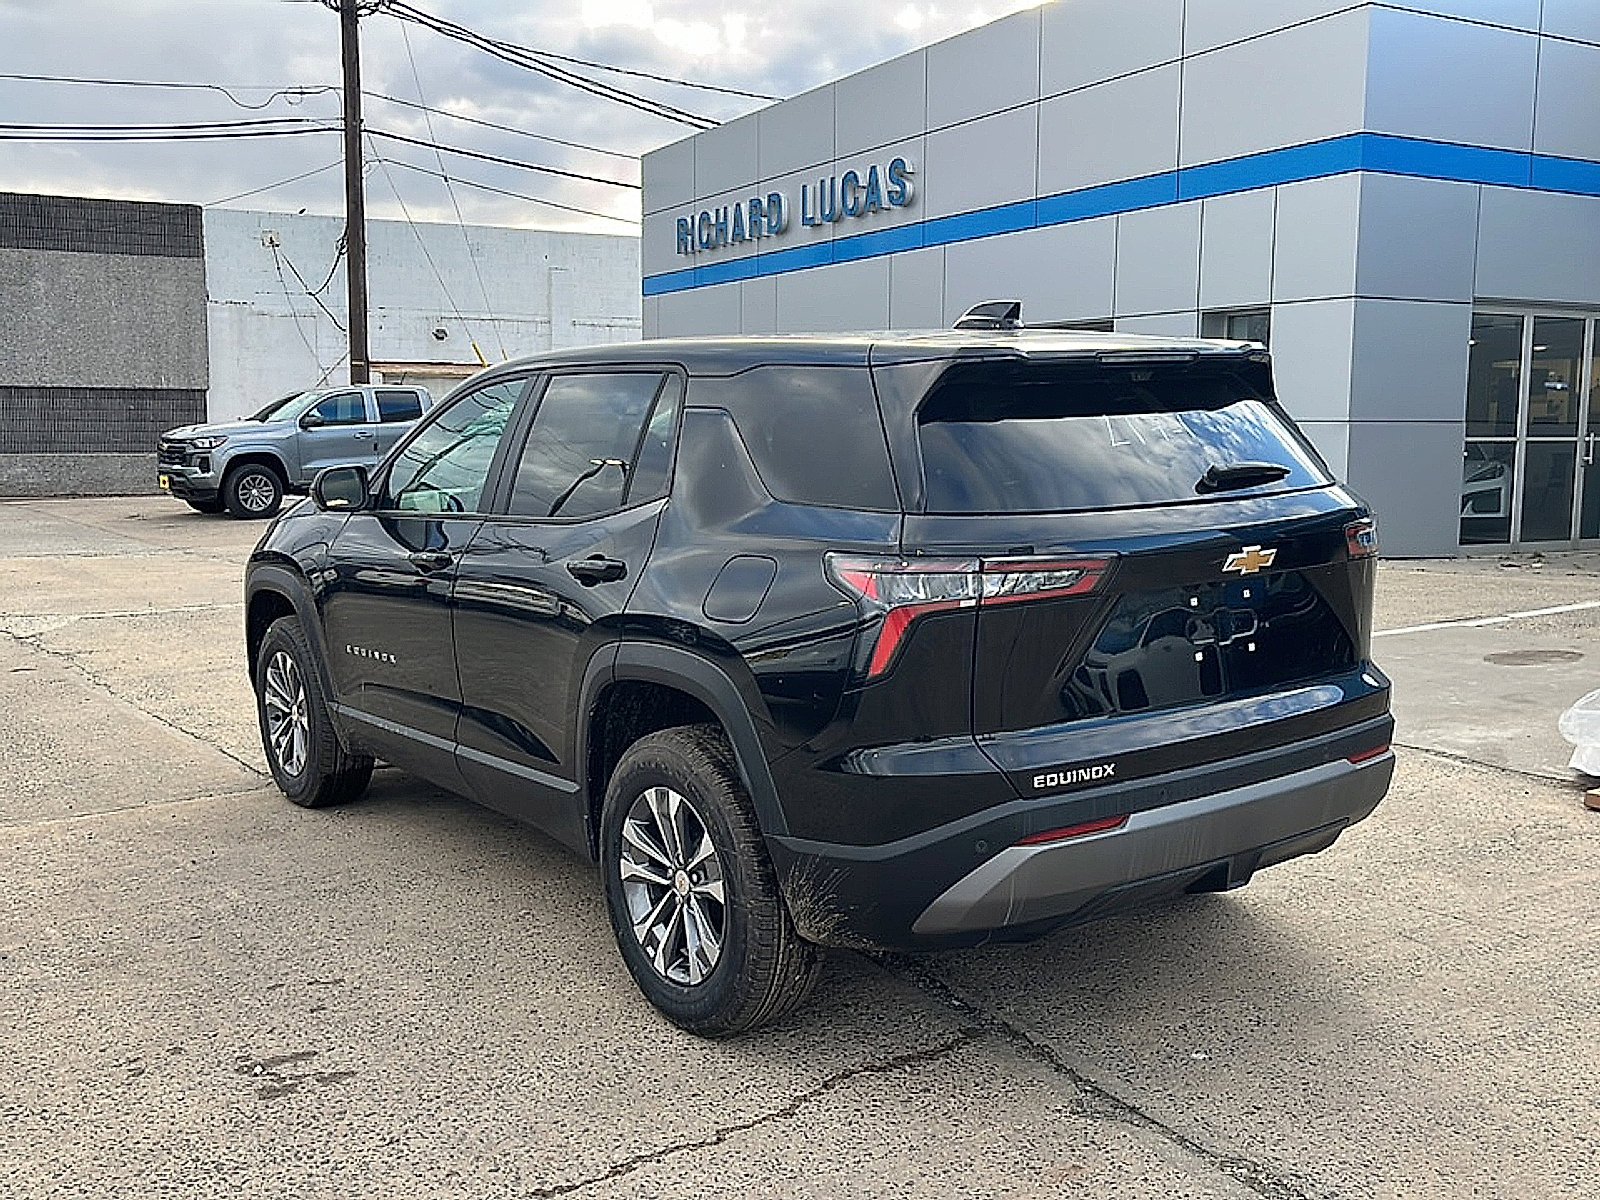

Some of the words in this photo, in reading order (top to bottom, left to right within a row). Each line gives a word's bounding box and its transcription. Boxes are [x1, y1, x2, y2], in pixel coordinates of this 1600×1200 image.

[676, 192, 786, 254] RICHARD
[801, 157, 911, 227] LUCAS
[1033, 762, 1116, 788] EQUINOX
